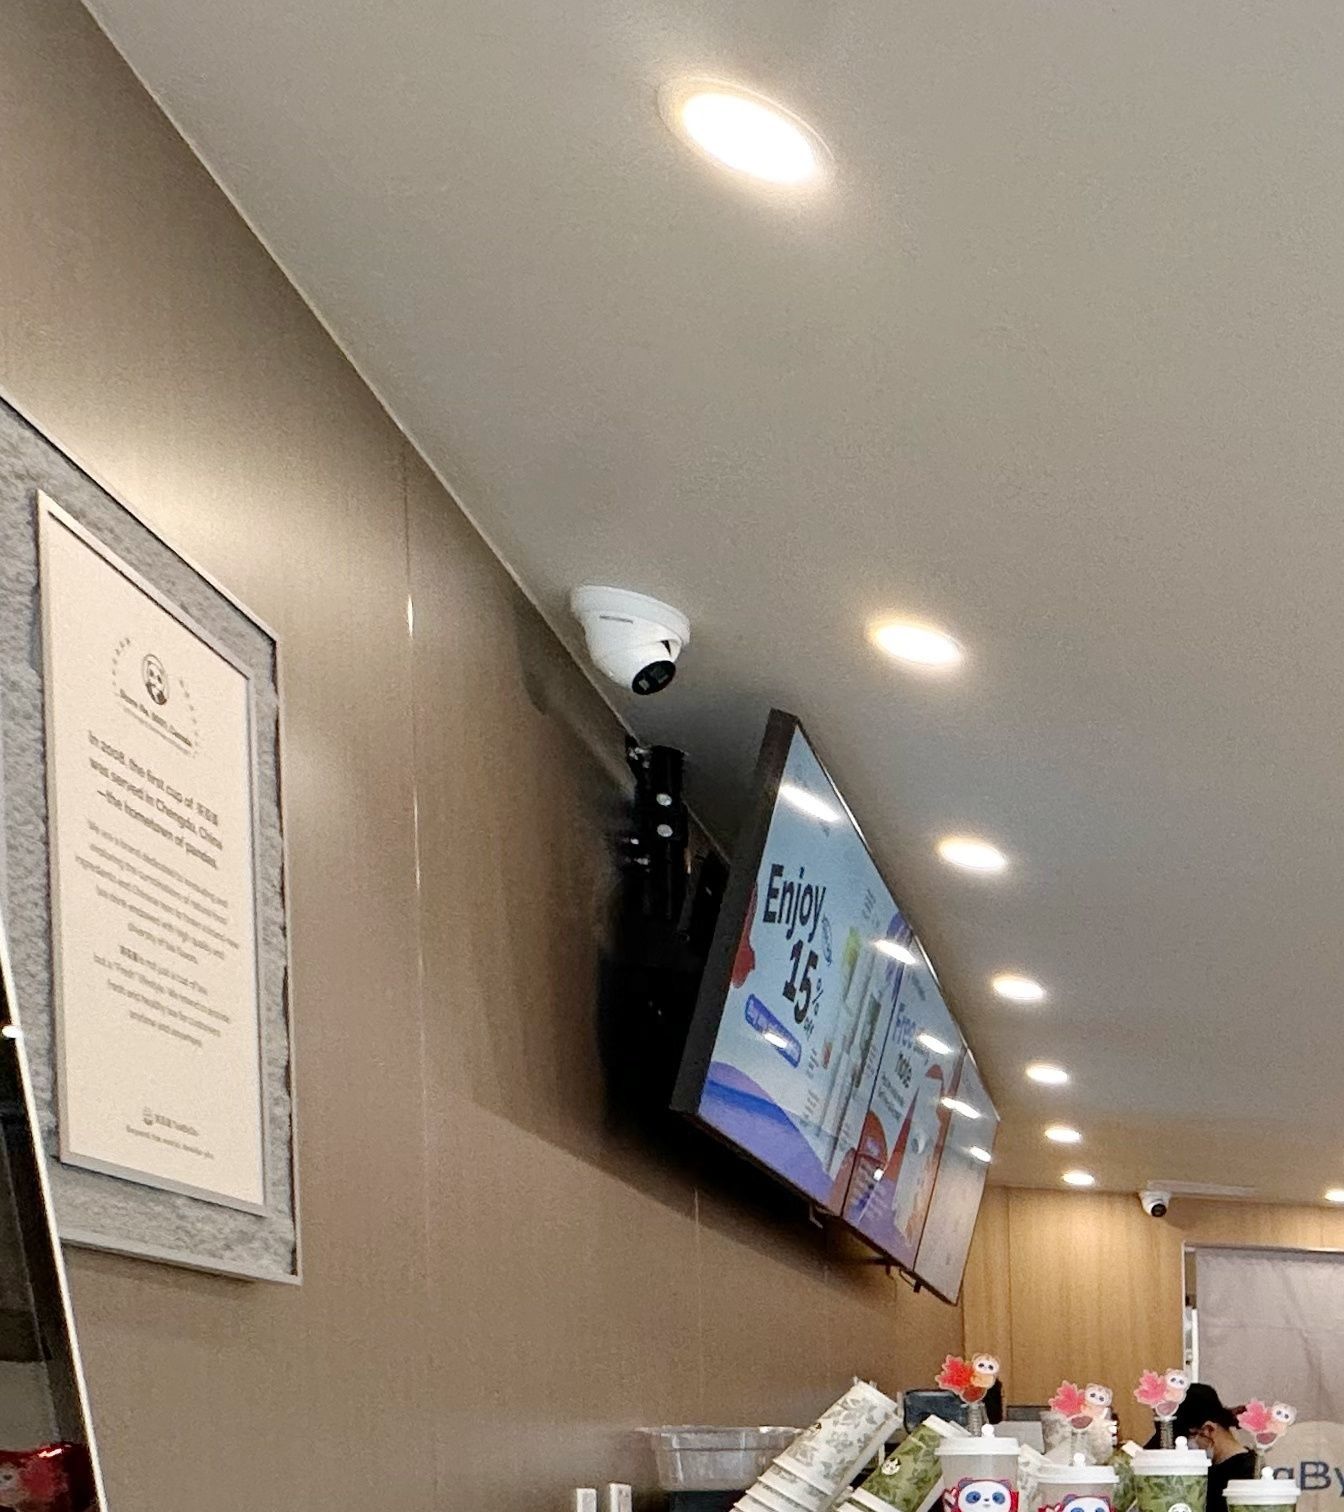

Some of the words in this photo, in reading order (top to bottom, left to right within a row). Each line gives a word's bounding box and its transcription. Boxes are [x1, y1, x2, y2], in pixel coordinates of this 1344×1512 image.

[129, 758, 145, 778] the
[184, 797, 194, 809] of
[124, 800, 173, 841] hometown
[174, 833, 184, 848] of
[199, 826, 223, 850] China
[763, 864, 827, 943] Enjoy
[782, 939, 818, 1024] 15
